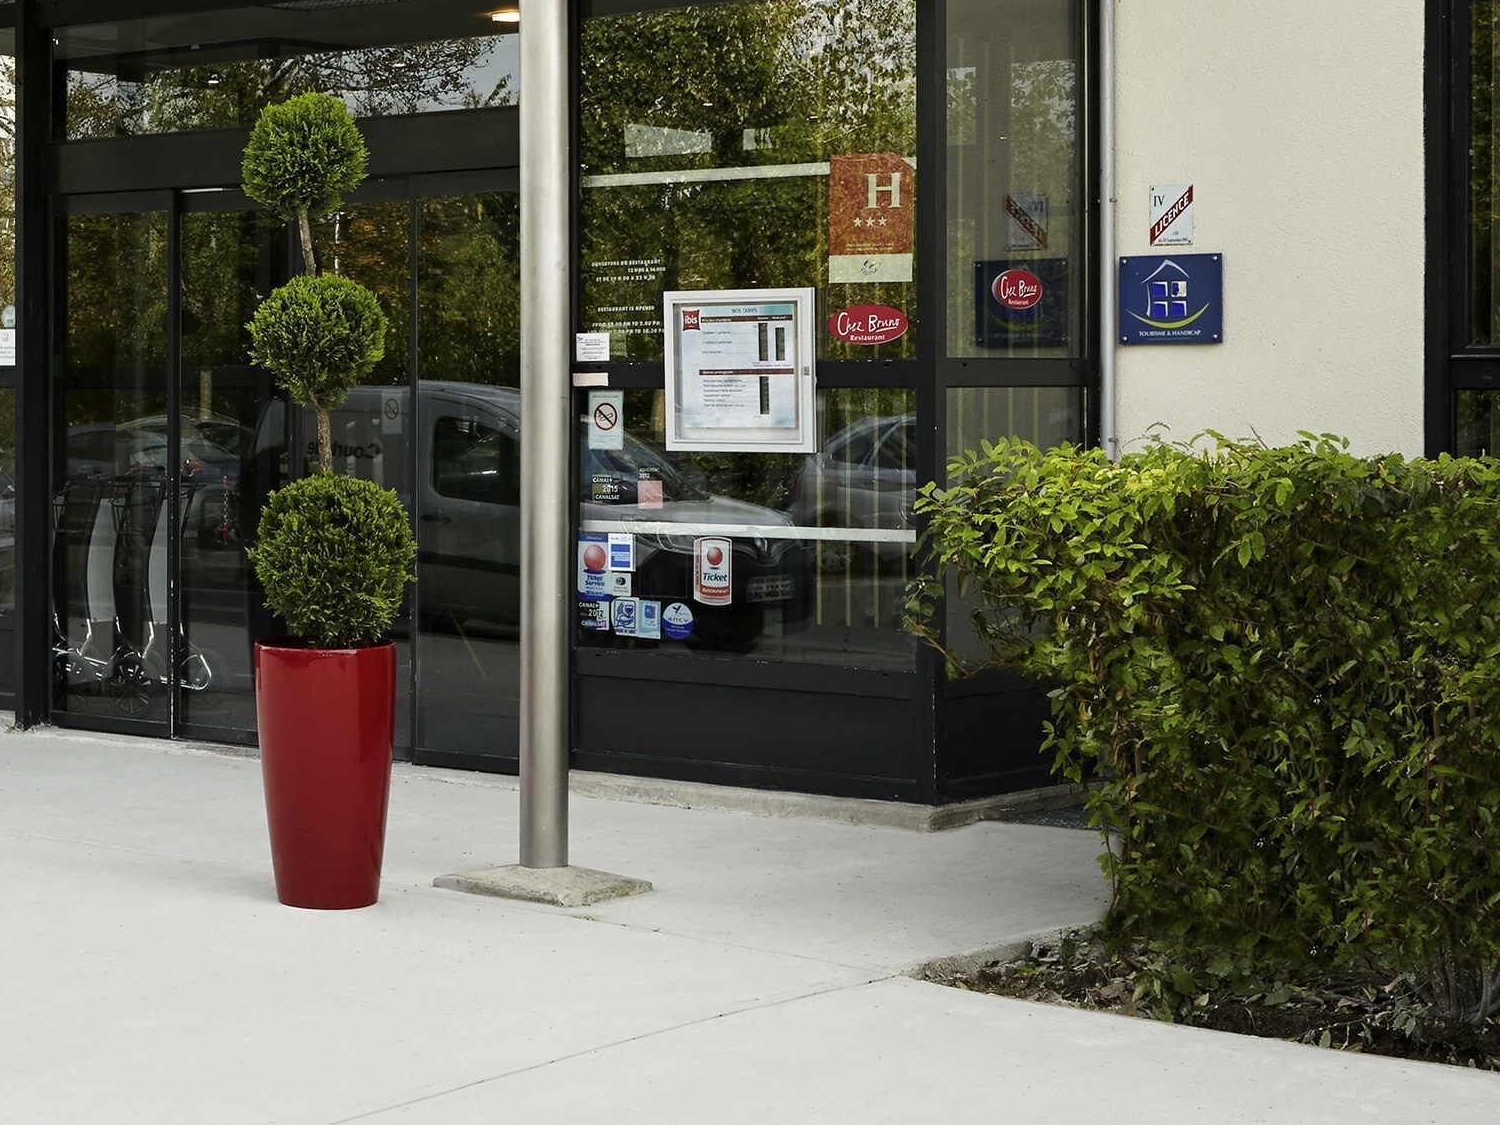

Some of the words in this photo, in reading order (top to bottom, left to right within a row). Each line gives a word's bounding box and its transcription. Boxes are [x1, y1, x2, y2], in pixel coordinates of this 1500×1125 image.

[864, 172, 903, 209] H
[1153, 195, 1165, 207] IV
[1154, 191, 1189, 238] LICENCE
[684, 314, 698, 324] ibis
[837, 311, 864, 336] Chez
[868, 314, 900, 333] Bruno
[702, 572, 728, 582] Ticket
